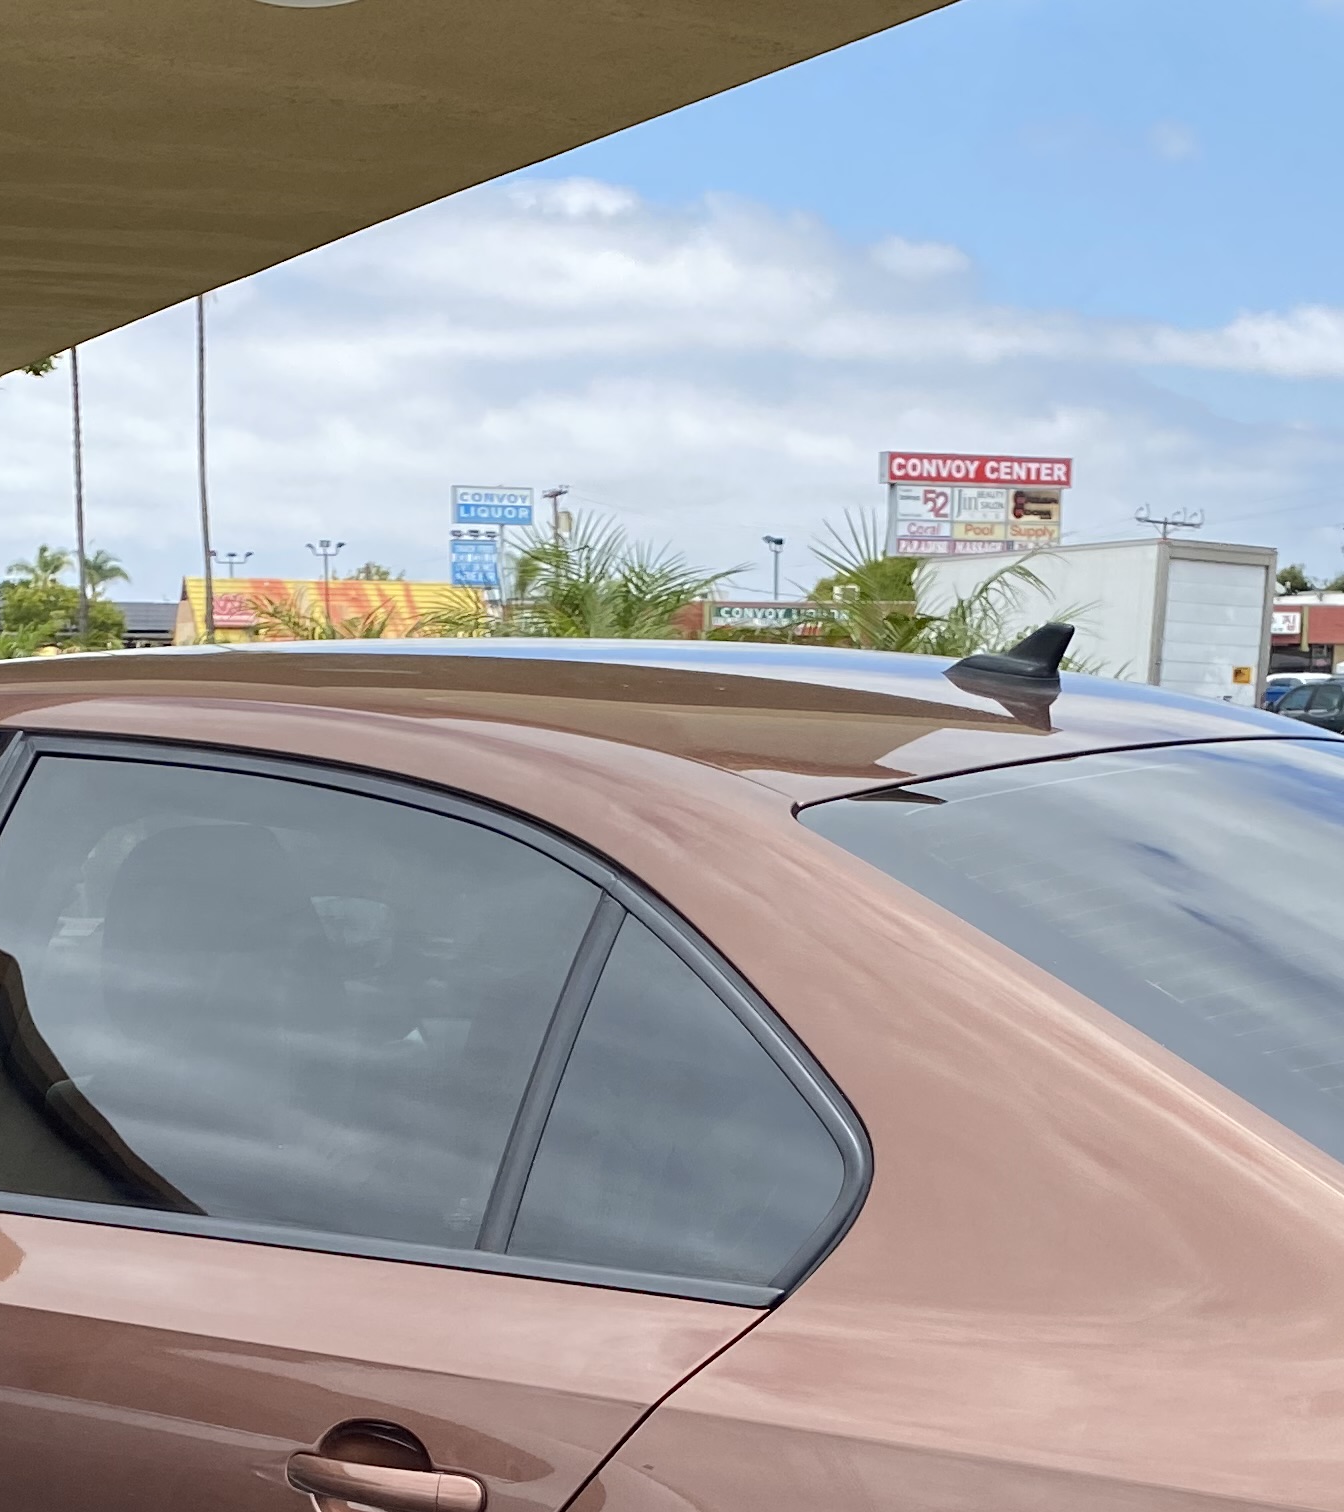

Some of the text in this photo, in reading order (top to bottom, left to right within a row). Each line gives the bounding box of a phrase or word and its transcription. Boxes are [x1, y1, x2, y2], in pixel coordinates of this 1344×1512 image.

[891, 457, 1068, 482] CONVOY CENTER
[459, 492, 529, 504] CONVOY
[922, 489, 949, 518] 52
[459, 506, 530, 519] LIQUOR
[907, 522, 1055, 540] Coral Pool Supply
[720, 607, 787, 619] CONVOY
